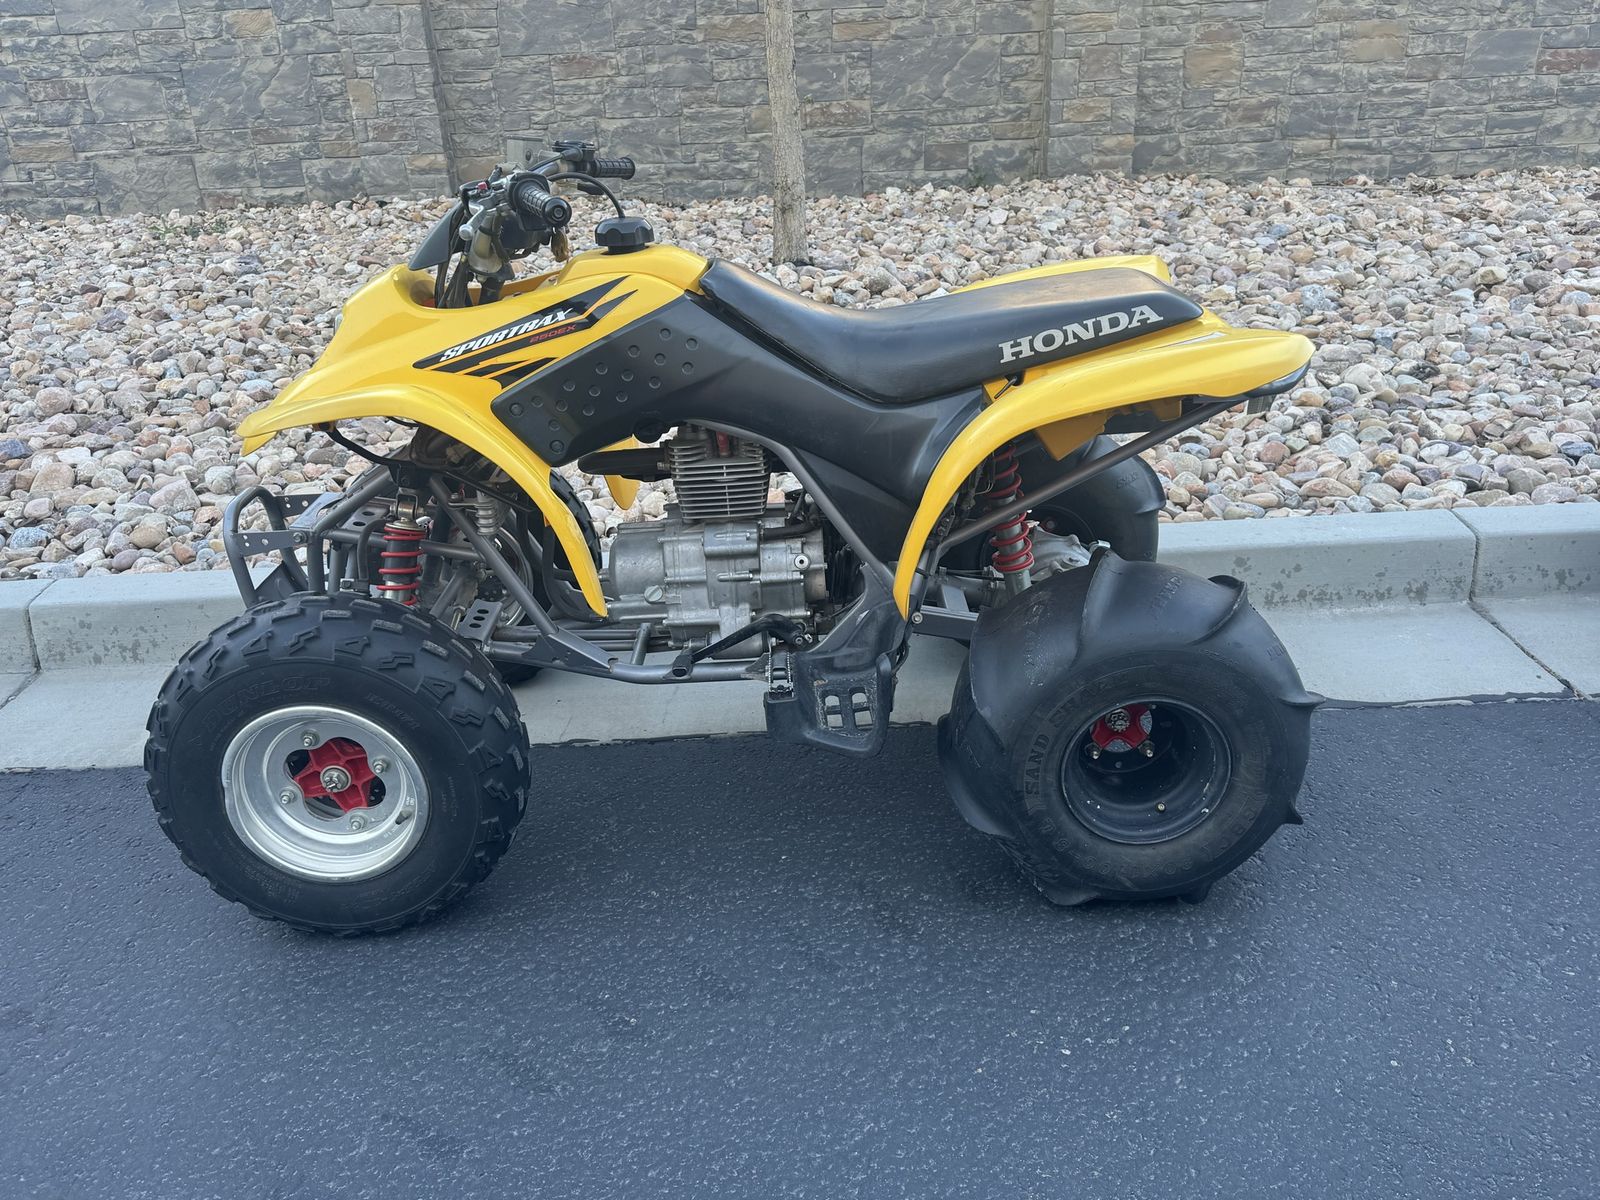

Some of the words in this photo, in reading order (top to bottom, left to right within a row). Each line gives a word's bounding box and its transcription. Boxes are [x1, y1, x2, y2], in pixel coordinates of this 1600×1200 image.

[439, 307, 573, 362] SPORTRAX
[529, 324, 577, 344] 250EX
[998, 304, 1164, 364] HONDA
[1024, 734, 1050, 795] SAND
